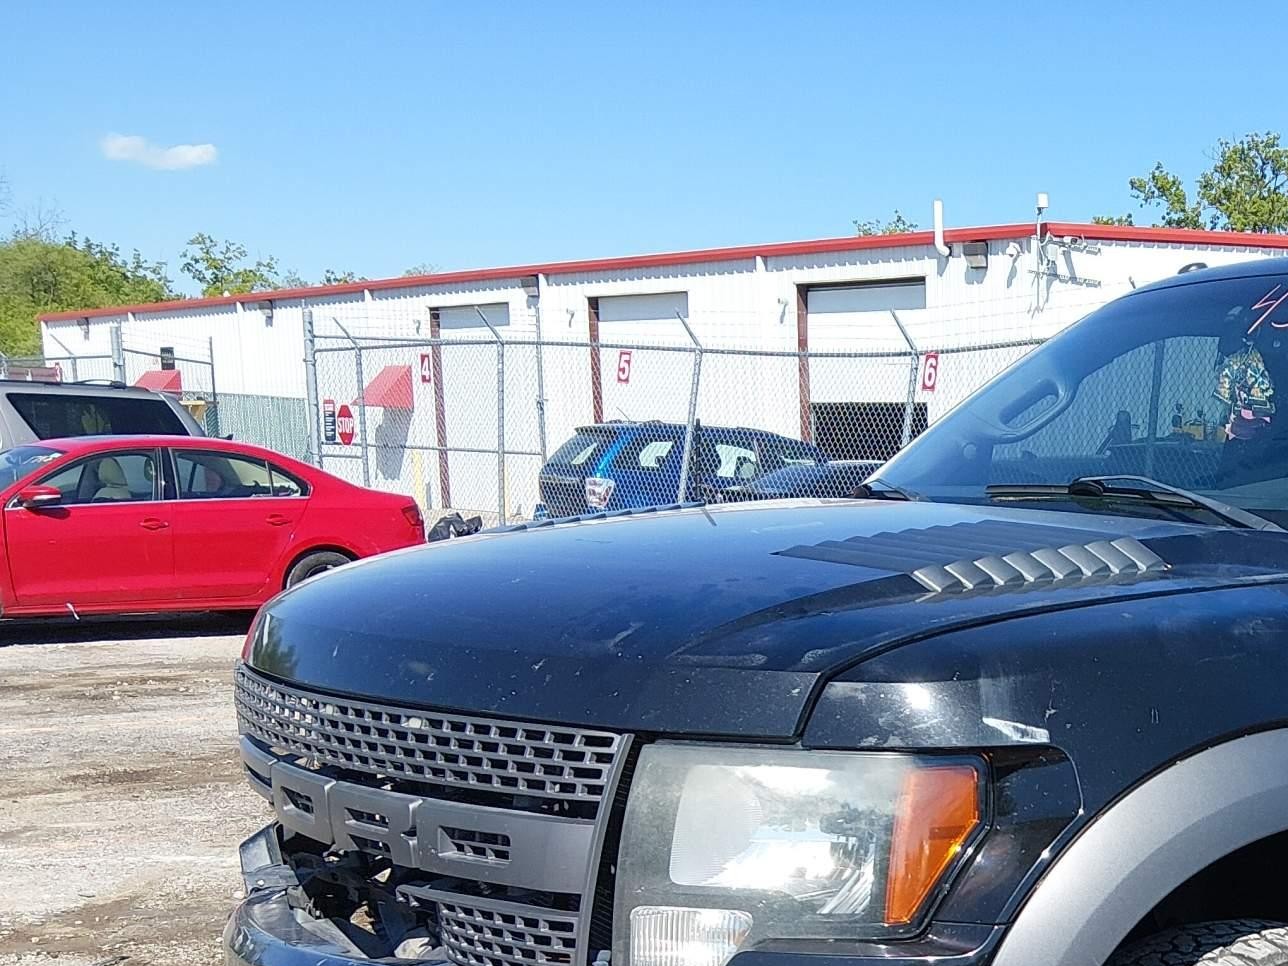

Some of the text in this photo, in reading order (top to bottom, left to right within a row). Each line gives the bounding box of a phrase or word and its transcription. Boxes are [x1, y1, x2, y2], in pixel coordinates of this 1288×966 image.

[421, 356, 430, 381] 4
[618, 353, 630, 381] 5
[924, 357, 937, 387] 6
[338, 417, 354, 434] STOP
